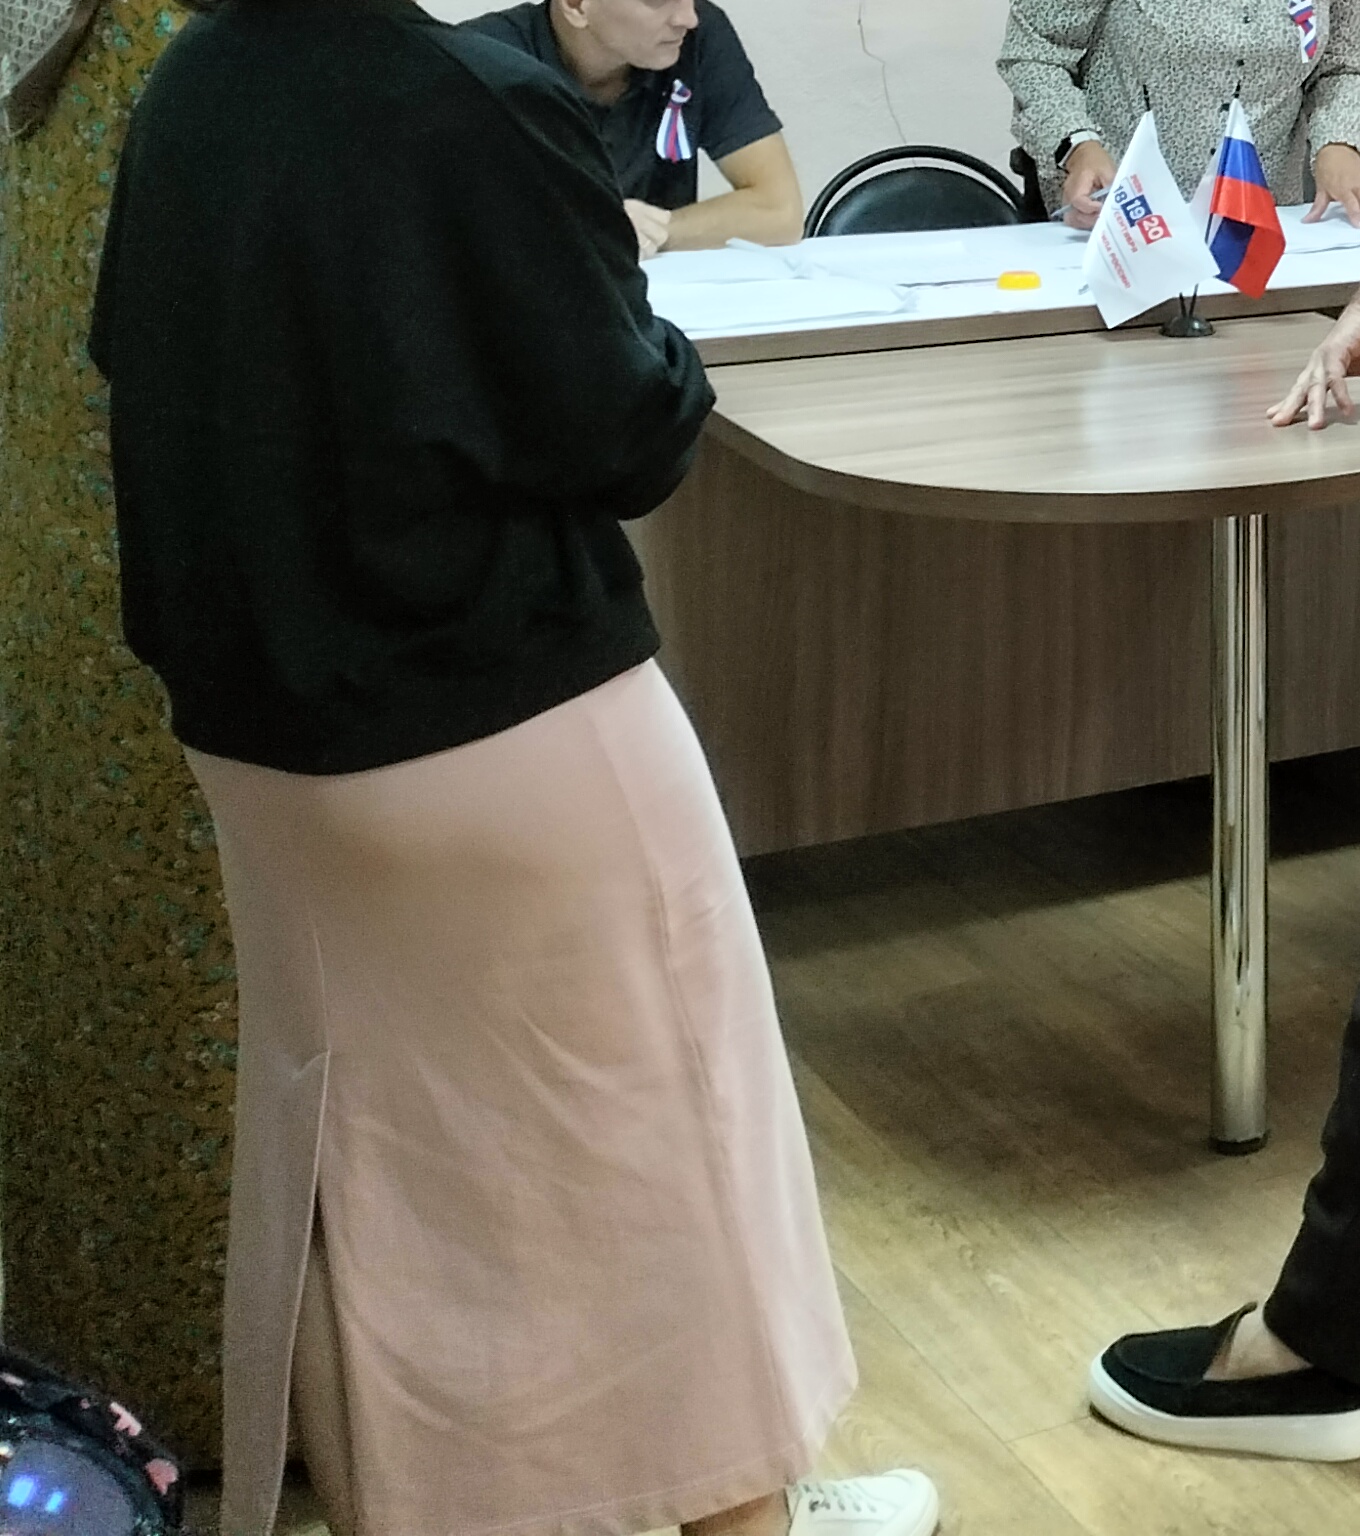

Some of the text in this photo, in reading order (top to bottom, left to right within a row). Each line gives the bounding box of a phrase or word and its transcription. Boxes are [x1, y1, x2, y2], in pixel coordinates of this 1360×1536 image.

[1113, 185, 1164, 240] 18 19 20
